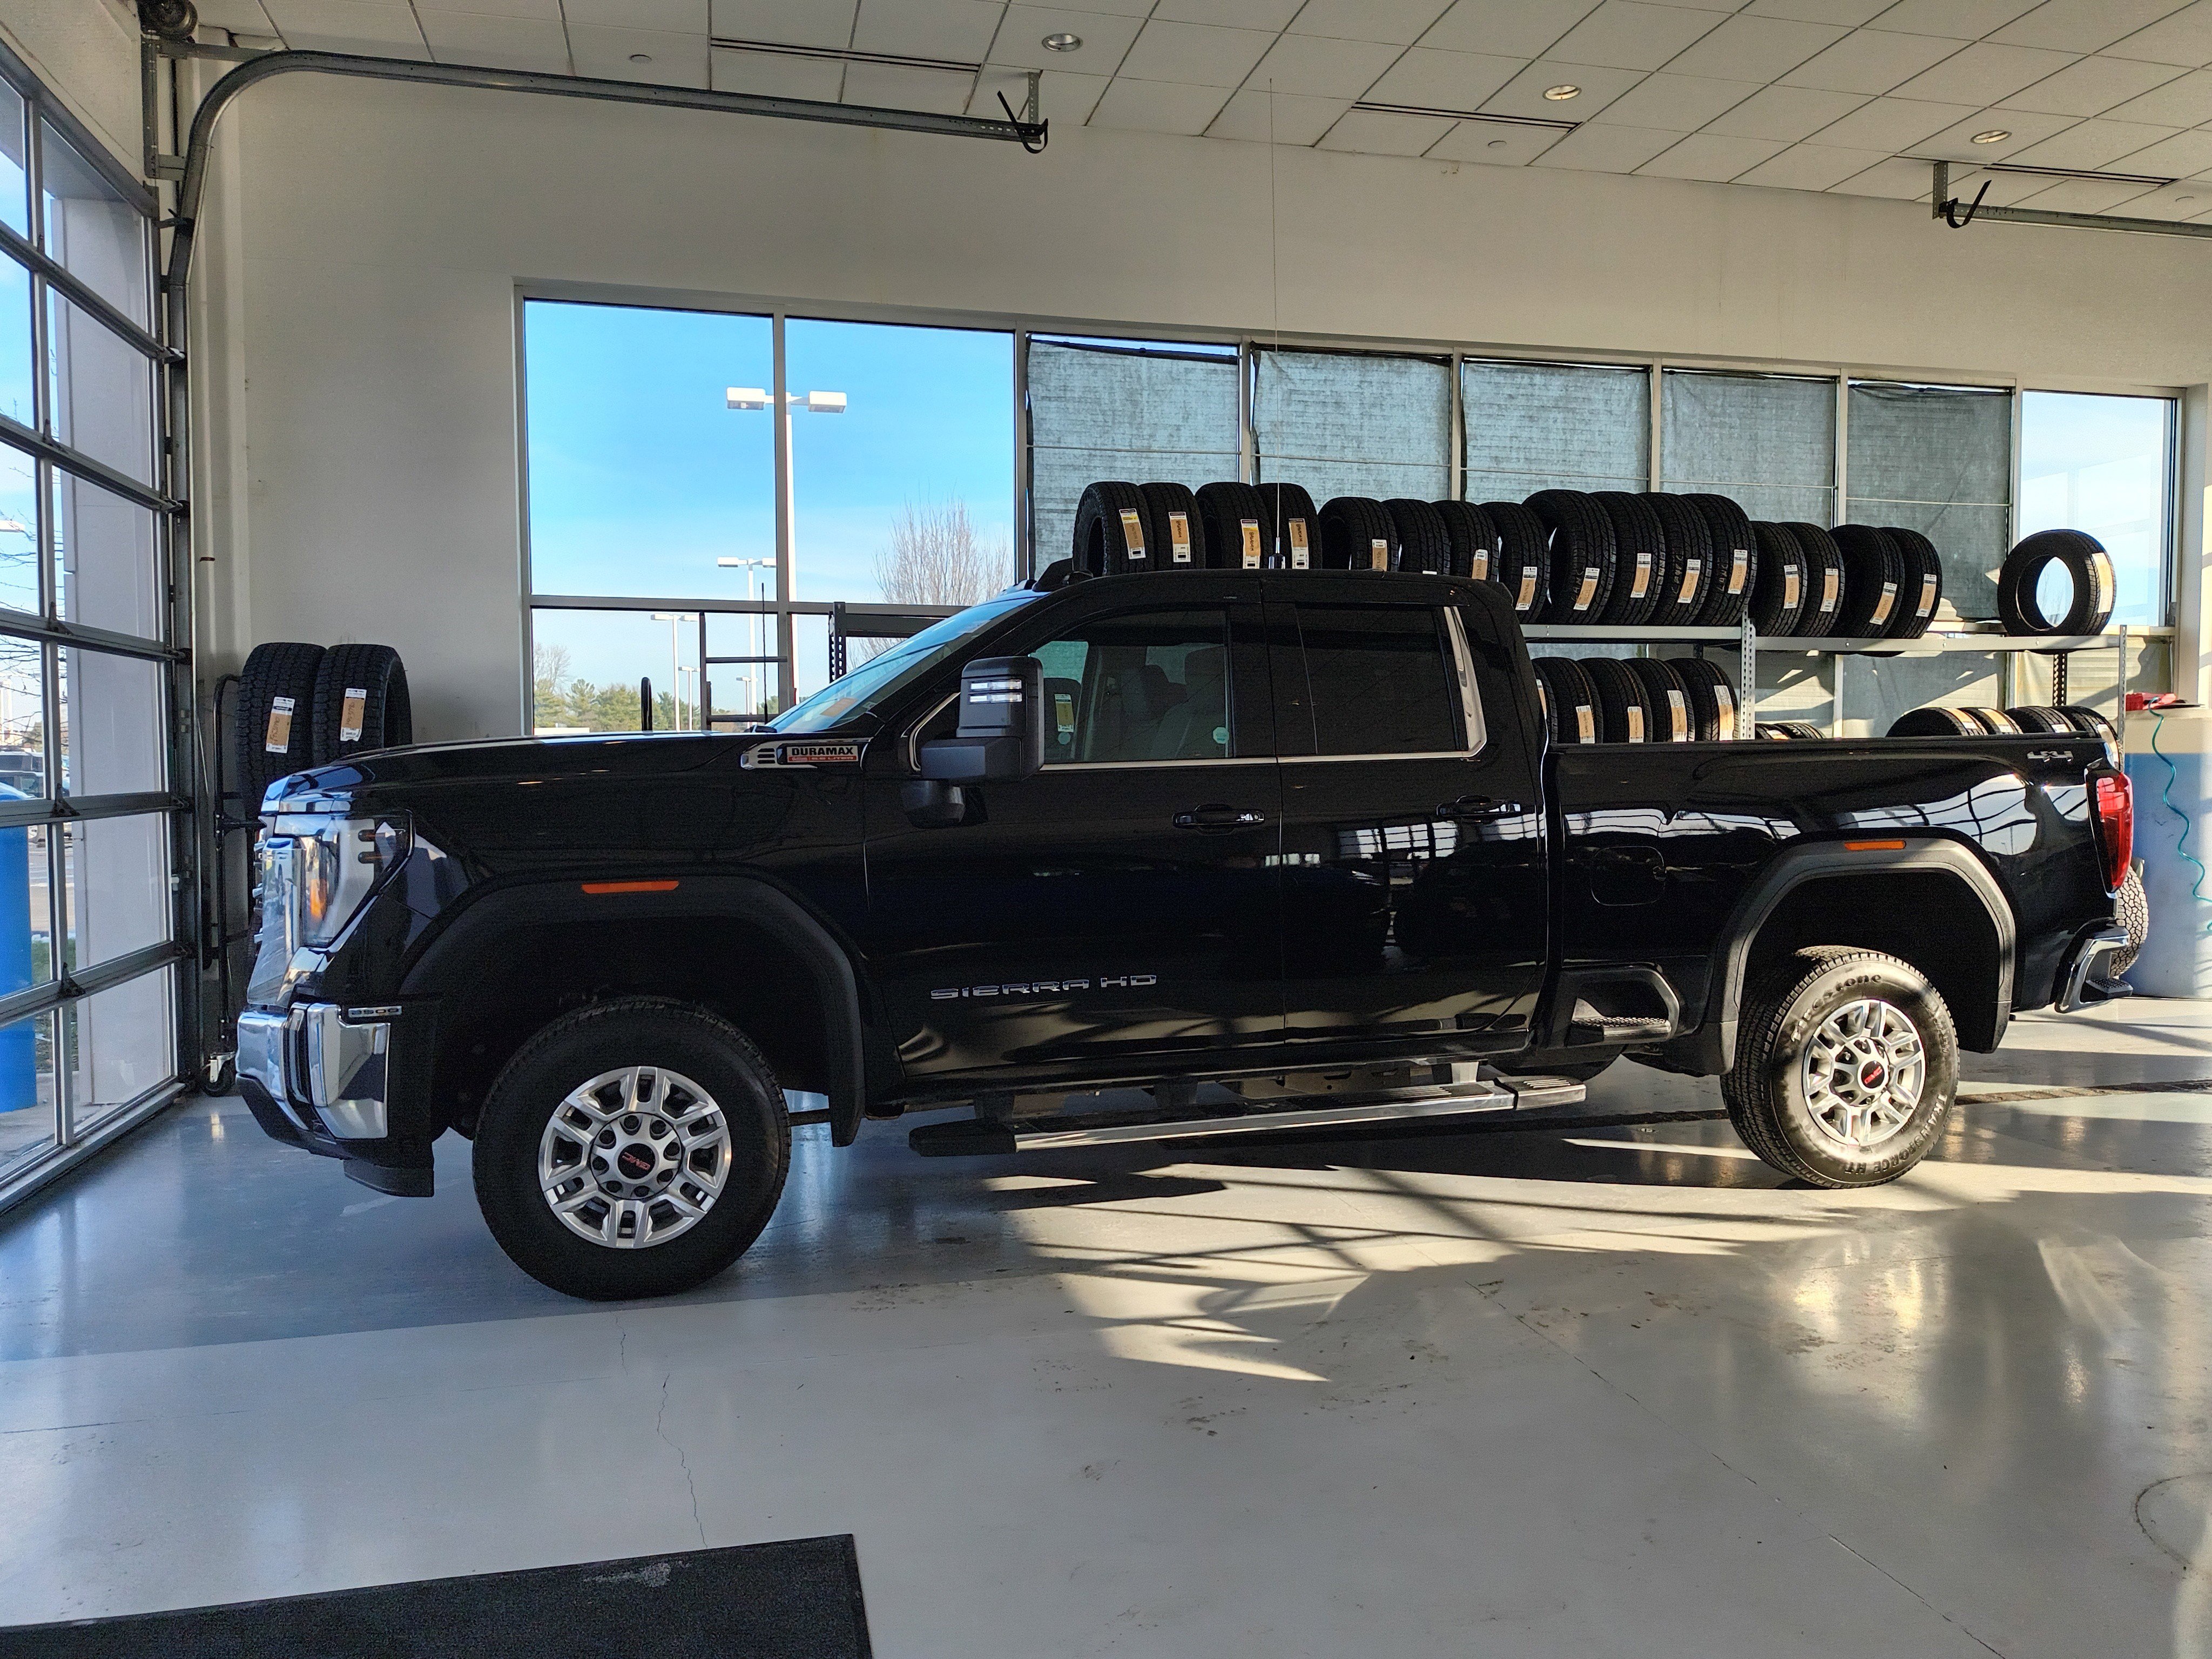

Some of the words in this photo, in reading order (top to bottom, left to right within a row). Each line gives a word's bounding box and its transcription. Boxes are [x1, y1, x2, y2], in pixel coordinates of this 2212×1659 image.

[792, 747, 853, 756] DURAMAX
[930, 979, 1090, 1000] SIERRA
[1100, 975, 1157, 988] HD
[1864, 1065, 1883, 1084] GMC
[1873, 1093, 1948, 1174] TRANSFORCE
[622, 1151, 651, 1171] GMC
[1844, 1162, 1867, 1175] HT
